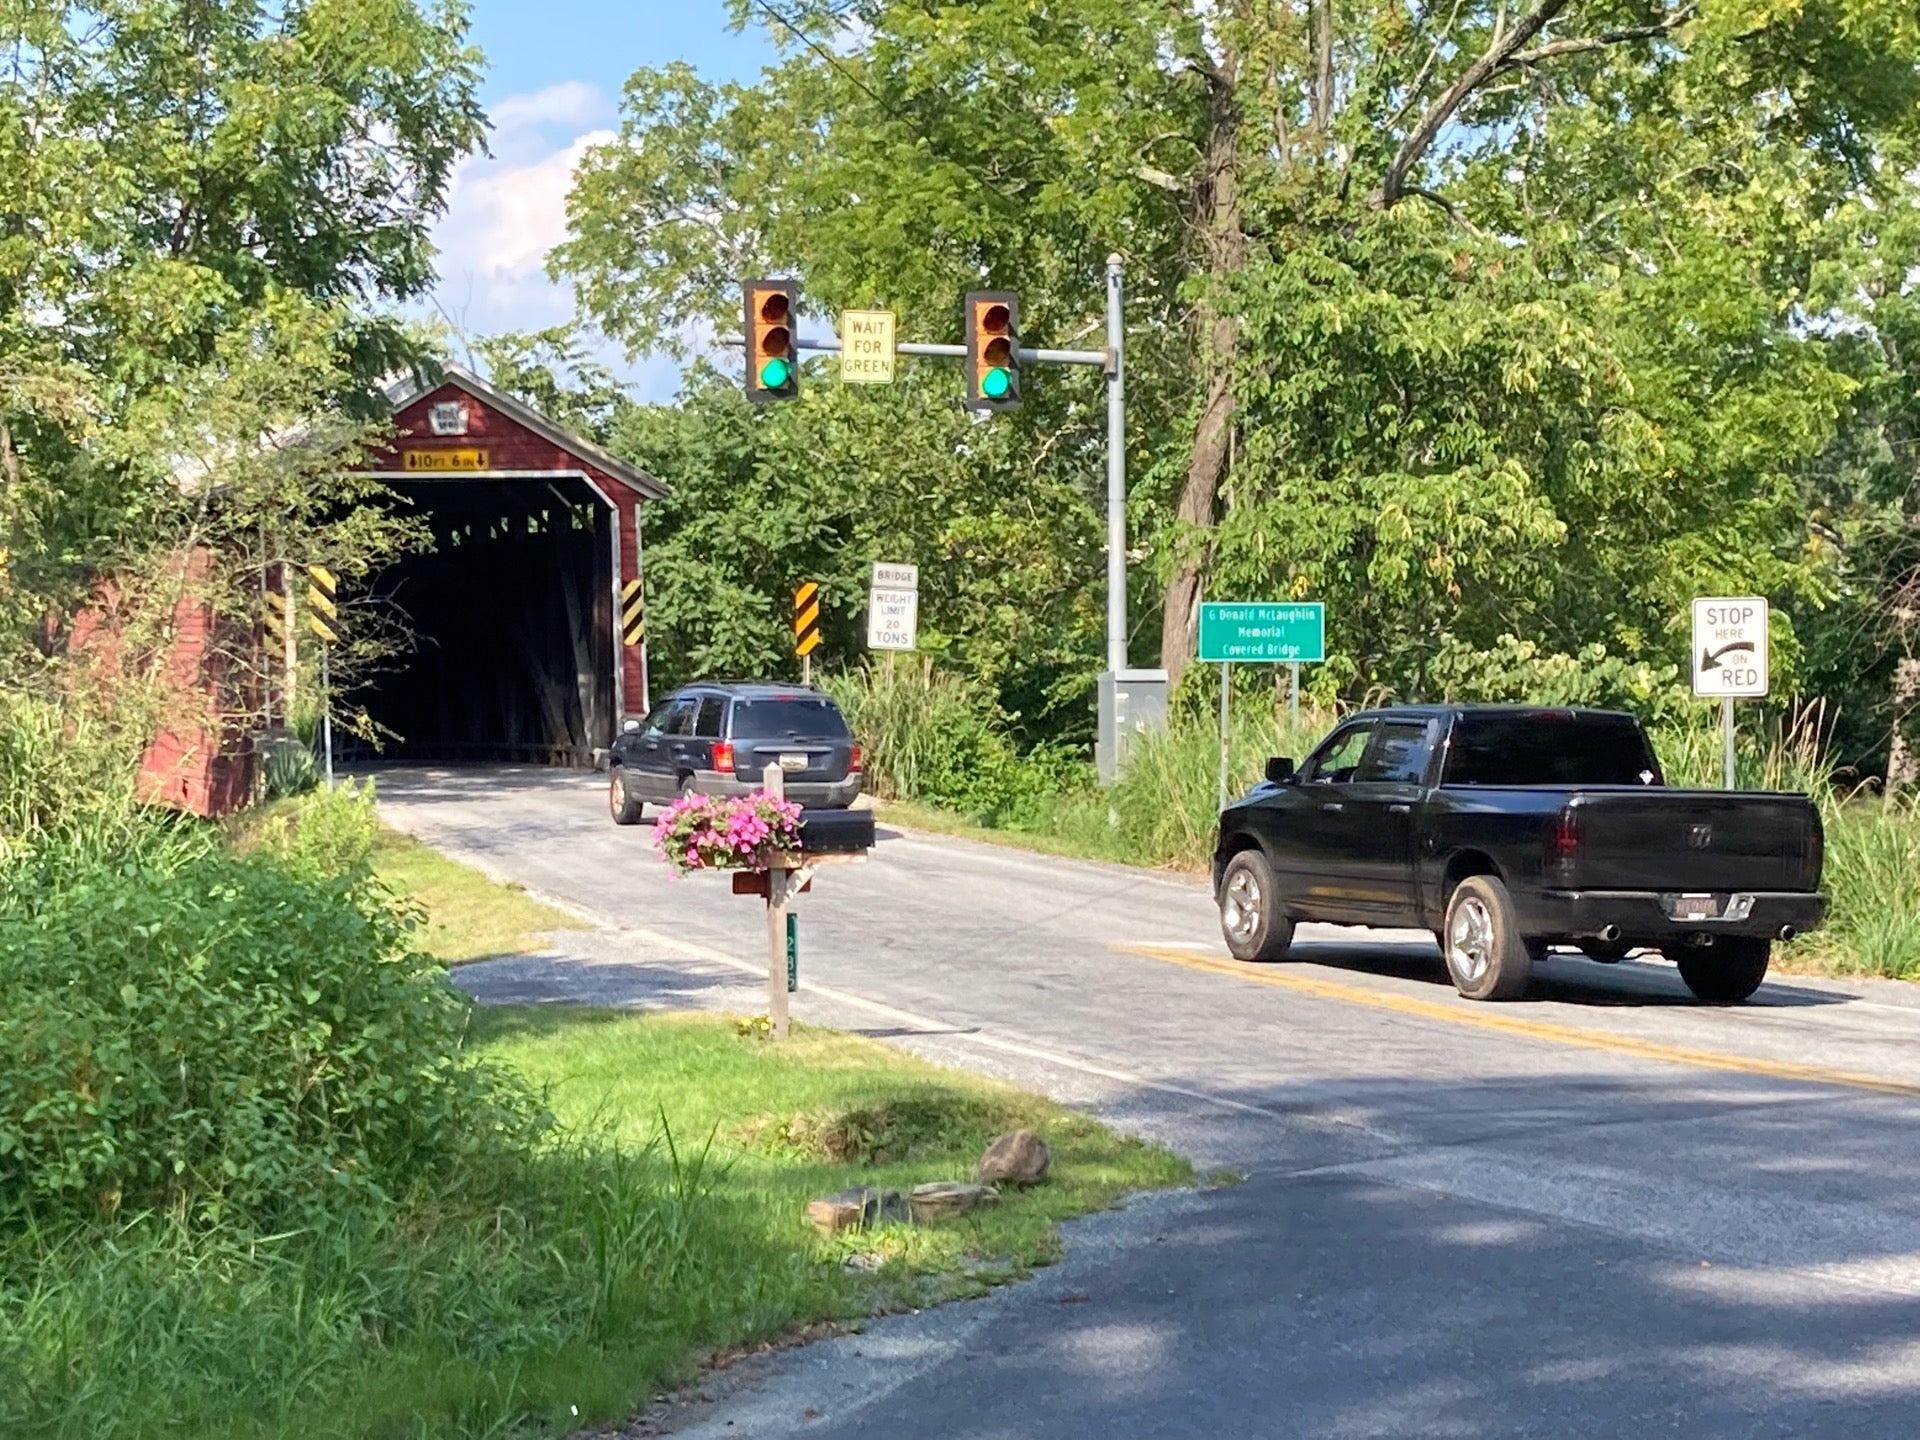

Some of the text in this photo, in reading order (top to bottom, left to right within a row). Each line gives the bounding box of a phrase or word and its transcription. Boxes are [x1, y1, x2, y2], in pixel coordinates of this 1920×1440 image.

[852, 320, 885, 334] WAIT
[854, 339, 882, 354] FOR
[844, 359, 890, 373] GREEN
[451, 454, 460, 468] 6
[877, 569, 913, 582] BRIDGE
[876, 593, 912, 605] WEIGHT
[881, 605, 906, 616] LIMIT
[1208, 607, 1316, 624] G Donald McLaughlin
[1706, 607, 1754, 626] STOP
[886, 619, 900, 630] 20
[1238, 625, 1286, 638] Memorial
[875, 631, 909, 645] TONS
[1715, 627, 1745, 641] HERE
[1222, 642, 1301, 658] Covered Bridge
[1732, 654, 1748, 665] ON
[1722, 668, 1758, 687] RED
